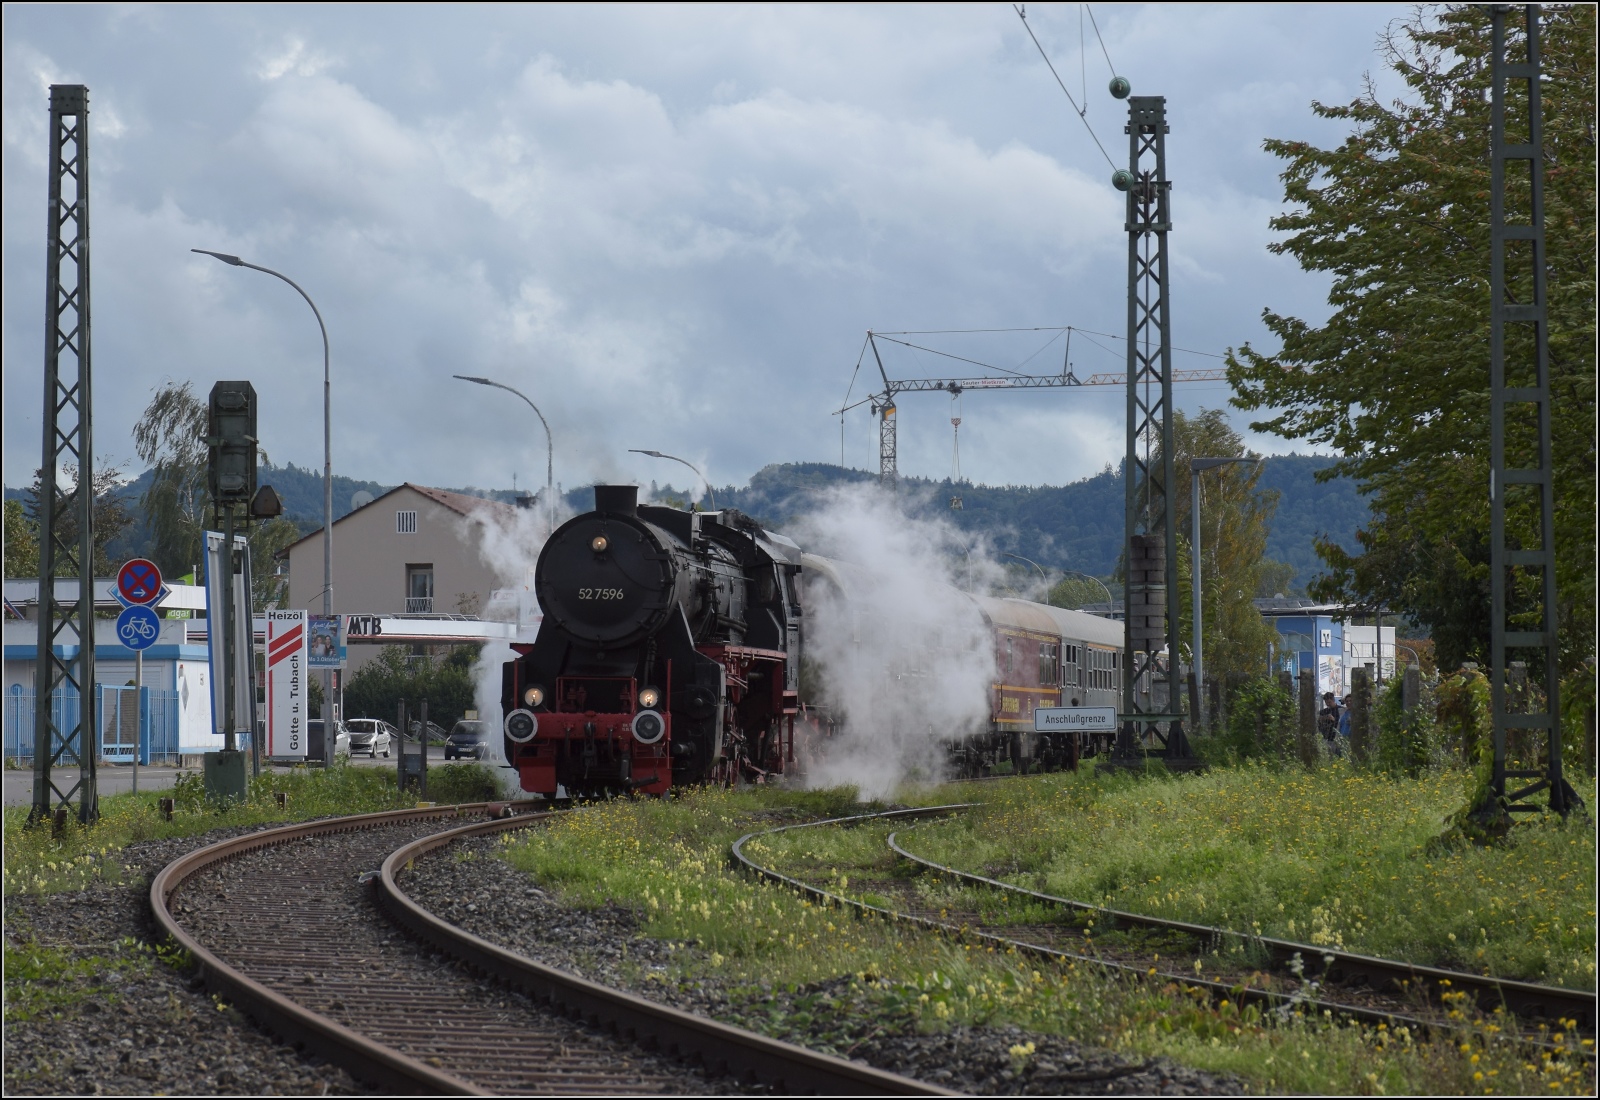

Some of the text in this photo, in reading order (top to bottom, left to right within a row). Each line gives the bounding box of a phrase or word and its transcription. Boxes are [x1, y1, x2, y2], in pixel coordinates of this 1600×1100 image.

[578, 588, 624, 600] 52 7596
[268, 611, 303, 620] Heizöl
[290, 655, 299, 751] Götte u. Tubach
[1045, 714, 1106, 726] Anschlußgrenze
